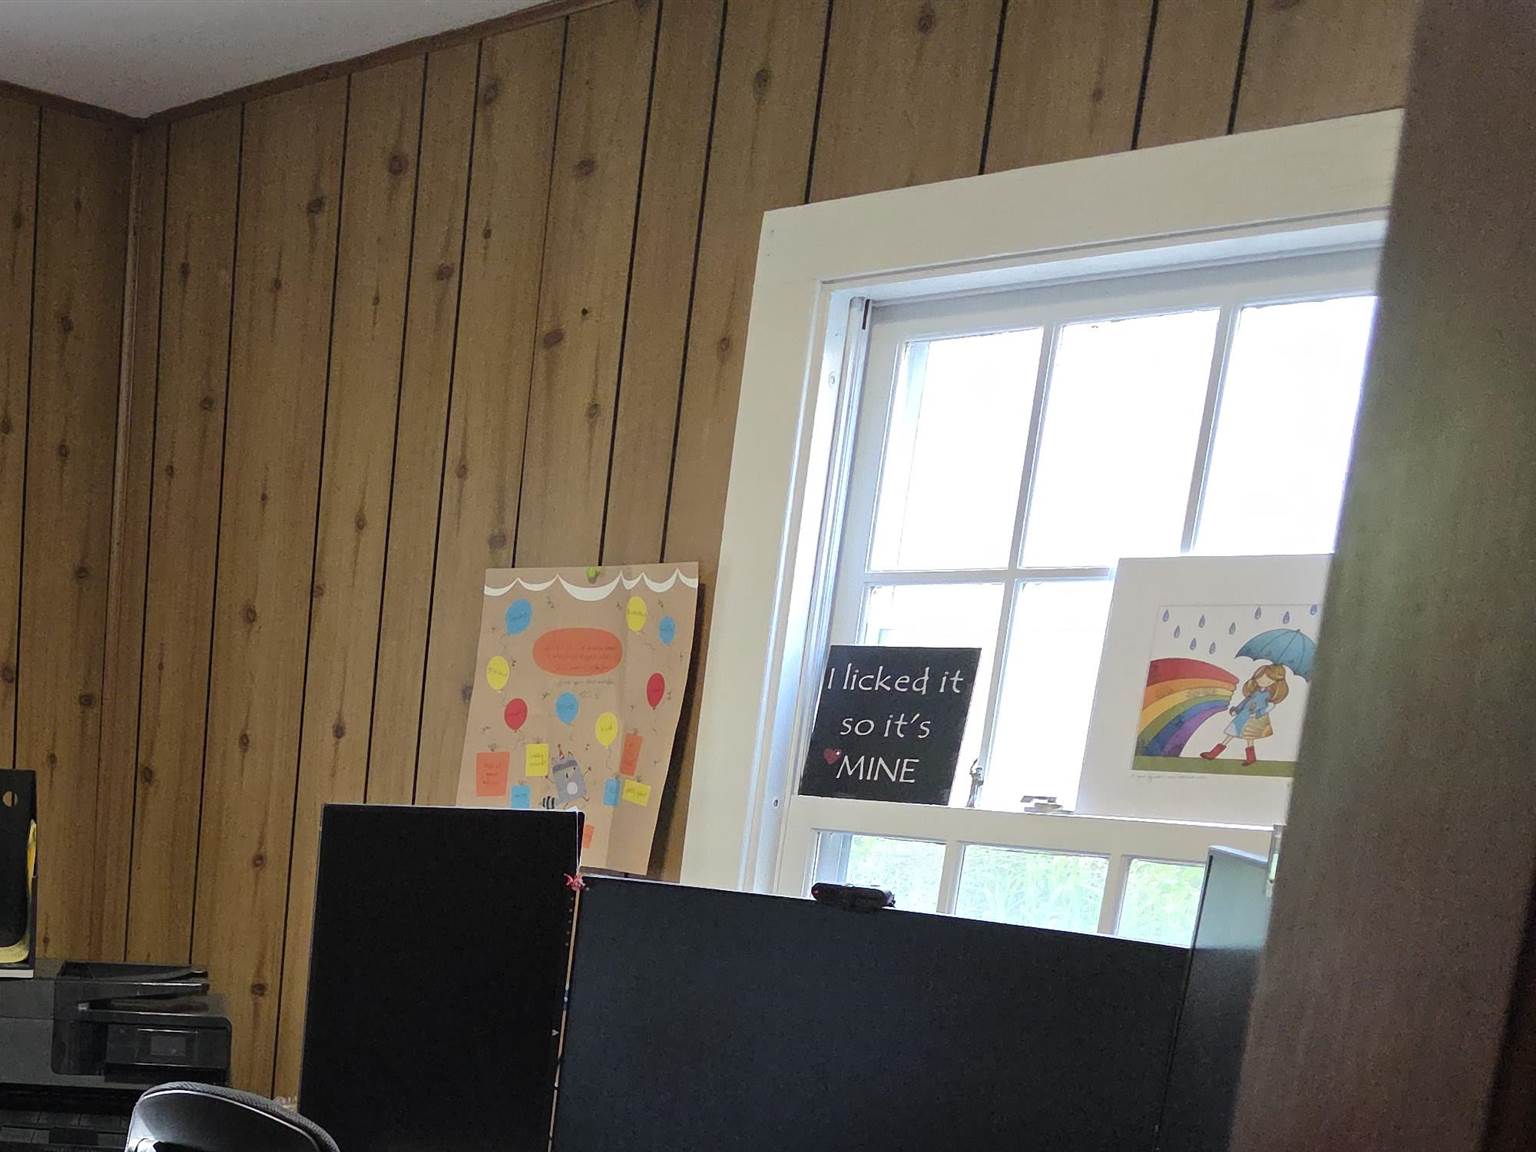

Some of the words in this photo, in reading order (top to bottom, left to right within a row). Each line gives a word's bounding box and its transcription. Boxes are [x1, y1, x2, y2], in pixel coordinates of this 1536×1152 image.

[827, 667, 836, 690] I
[842, 662, 931, 696] licked
[939, 669, 964, 694] it
[839, 717, 875, 736] so
[883, 712, 932, 739] it's
[835, 754, 920, 783] MINE
